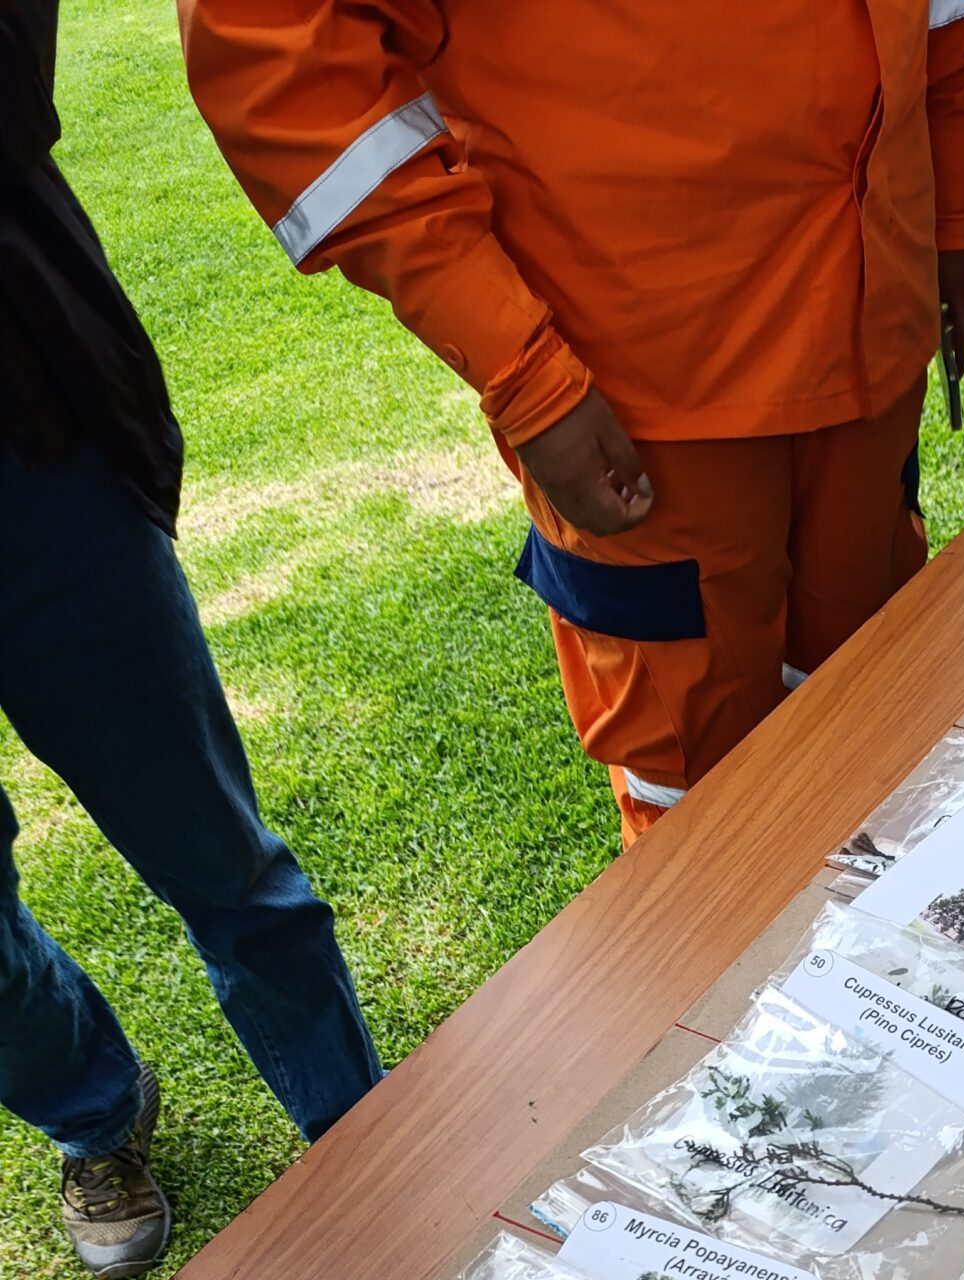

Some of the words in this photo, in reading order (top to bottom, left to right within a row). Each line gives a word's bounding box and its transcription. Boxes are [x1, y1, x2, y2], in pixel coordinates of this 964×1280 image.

[810, 956, 825, 969] 50
[844, 977, 917, 1023] Cupressus
[859, 1007, 898, 1034] (Pino
[900, 1028, 953, 1064] Ciprés)
[591, 1209, 609, 1223] 86
[624, 1218, 682, 1248] Myrcia
